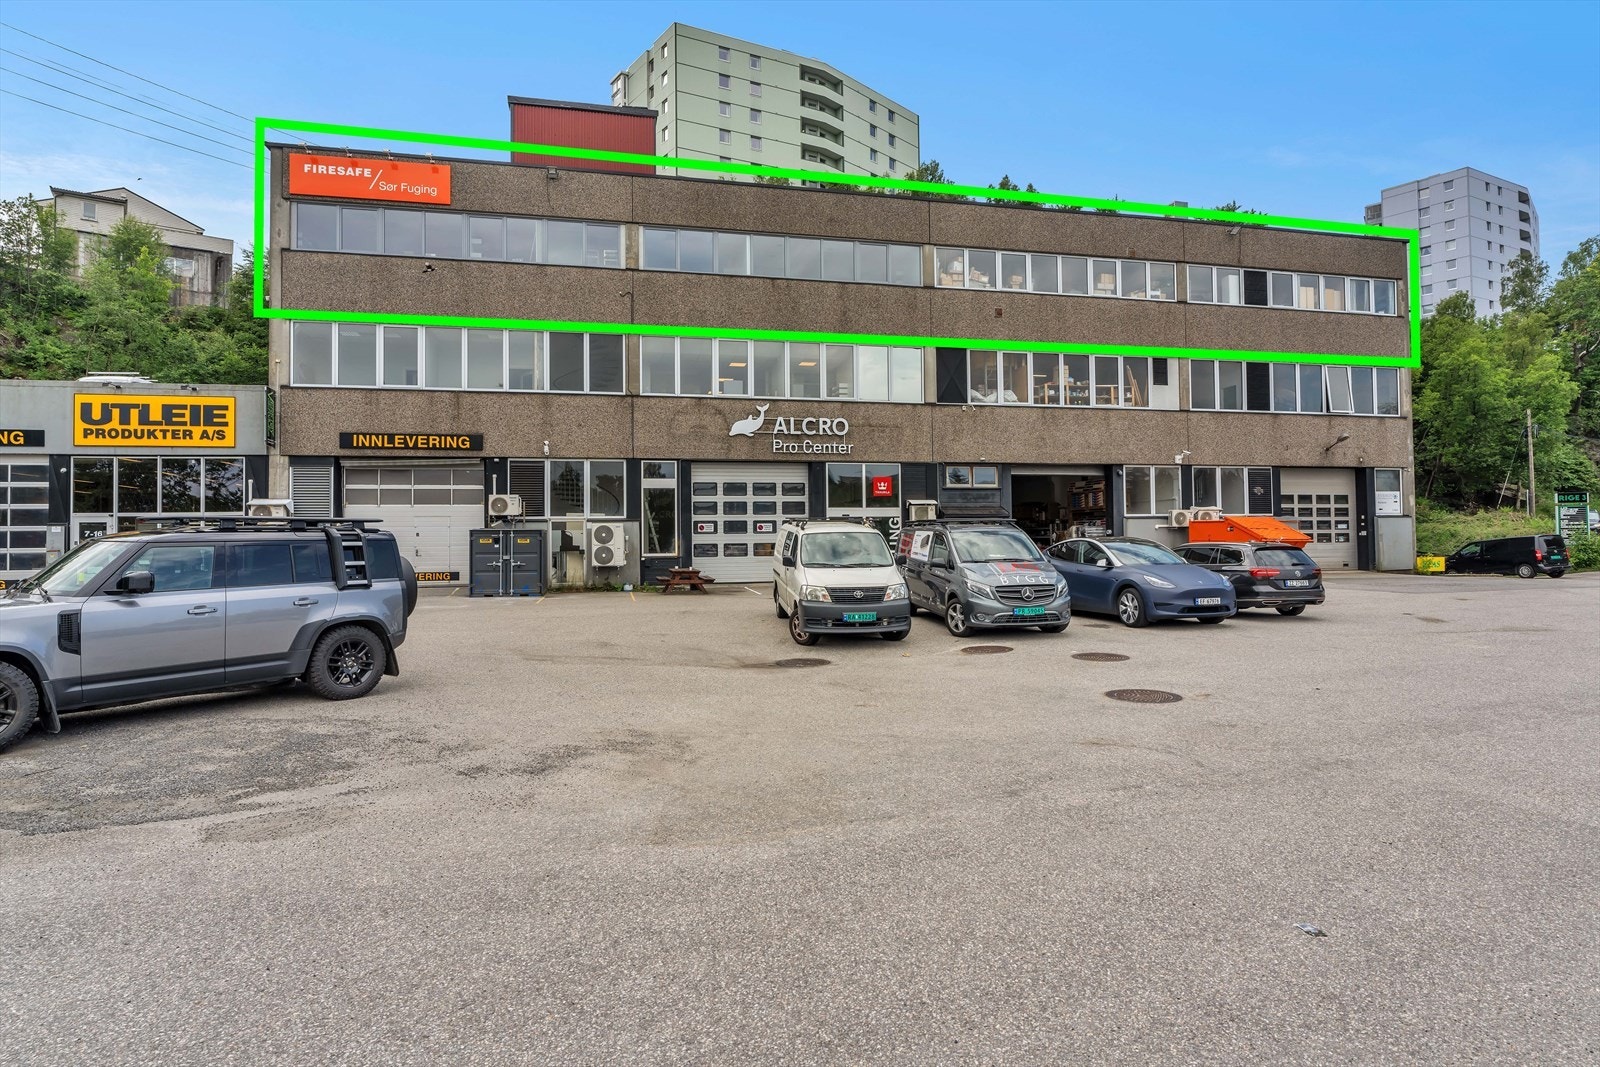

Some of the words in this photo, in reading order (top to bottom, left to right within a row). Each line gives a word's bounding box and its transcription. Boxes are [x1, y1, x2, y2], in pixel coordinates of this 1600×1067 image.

[304, 164, 372, 177] FIRESAFE
[379, 181, 398, 191] Sør
[401, 183, 437, 196] Fuging
[80, 402, 229, 427] UTLEIE
[773, 417, 849, 436] ALCRO
[83, 428, 193, 440] PRODUKTER
[199, 429, 226, 441] A/S
[352, 434, 470, 448] INNLEVERING
[773, 440, 798, 453] Pro
[803, 440, 854, 454] Center
[1000, 574, 1049, 585] BYGG
